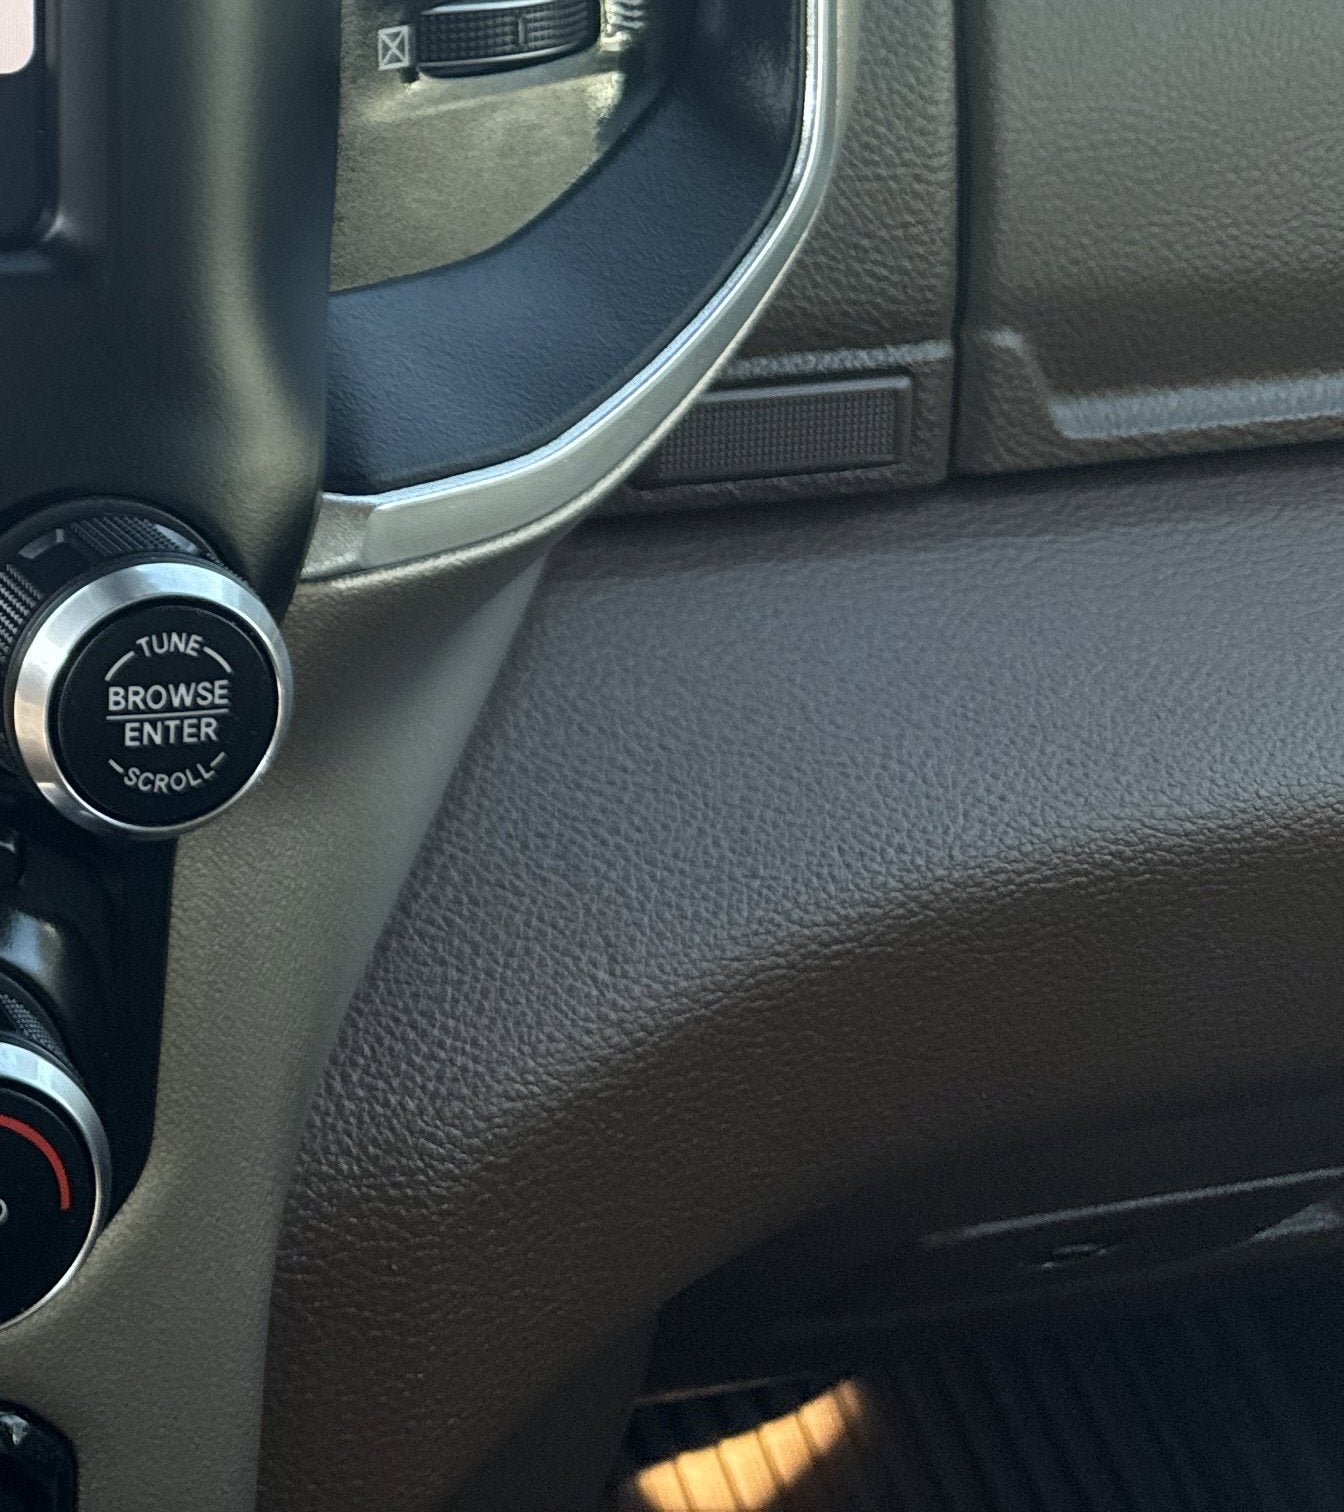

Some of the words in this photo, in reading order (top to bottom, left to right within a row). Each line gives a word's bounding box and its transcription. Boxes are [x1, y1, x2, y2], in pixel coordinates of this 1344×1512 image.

[135, 632, 205, 659] TUNE
[108, 679, 230, 712] BROWSE
[124, 717, 219, 747] ENTER
[123, 760, 216, 794] SCROLL
